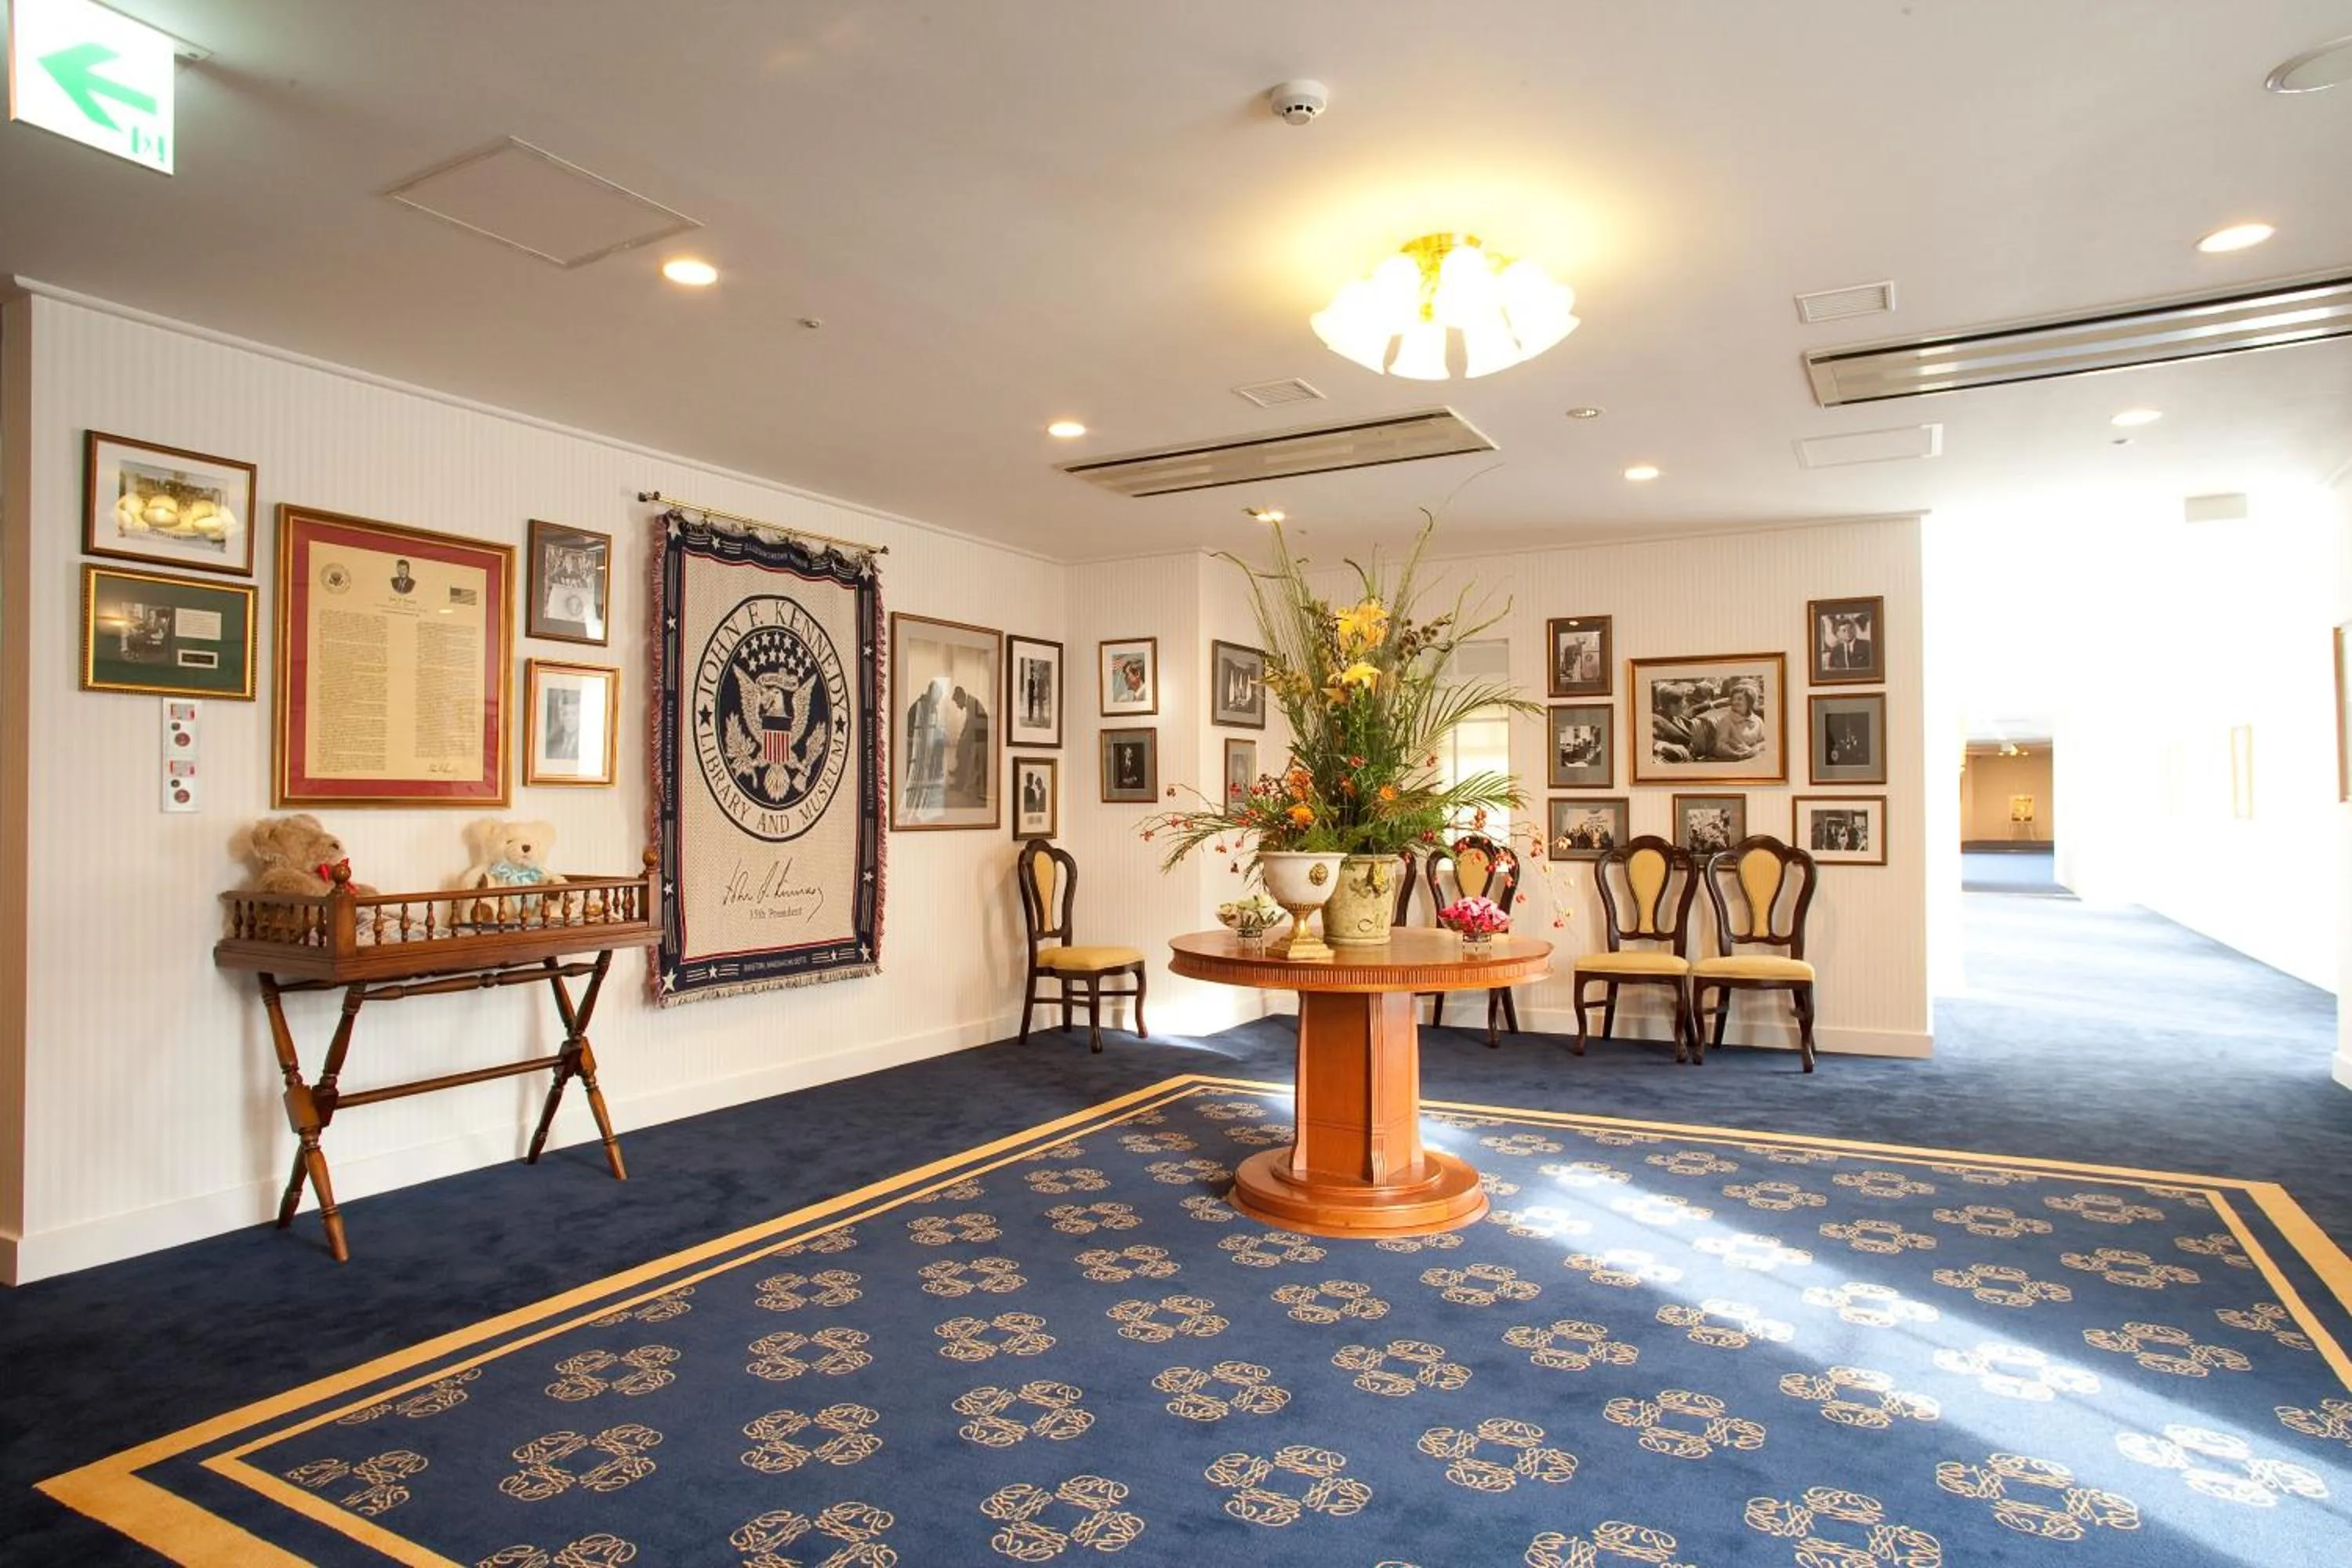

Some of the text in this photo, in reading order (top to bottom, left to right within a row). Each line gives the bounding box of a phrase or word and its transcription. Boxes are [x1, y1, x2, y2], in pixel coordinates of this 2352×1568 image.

[699, 601, 848, 712] JOHN F. KENNEDY
[700, 731, 844, 833] LIBRARY AND MUSEUM
